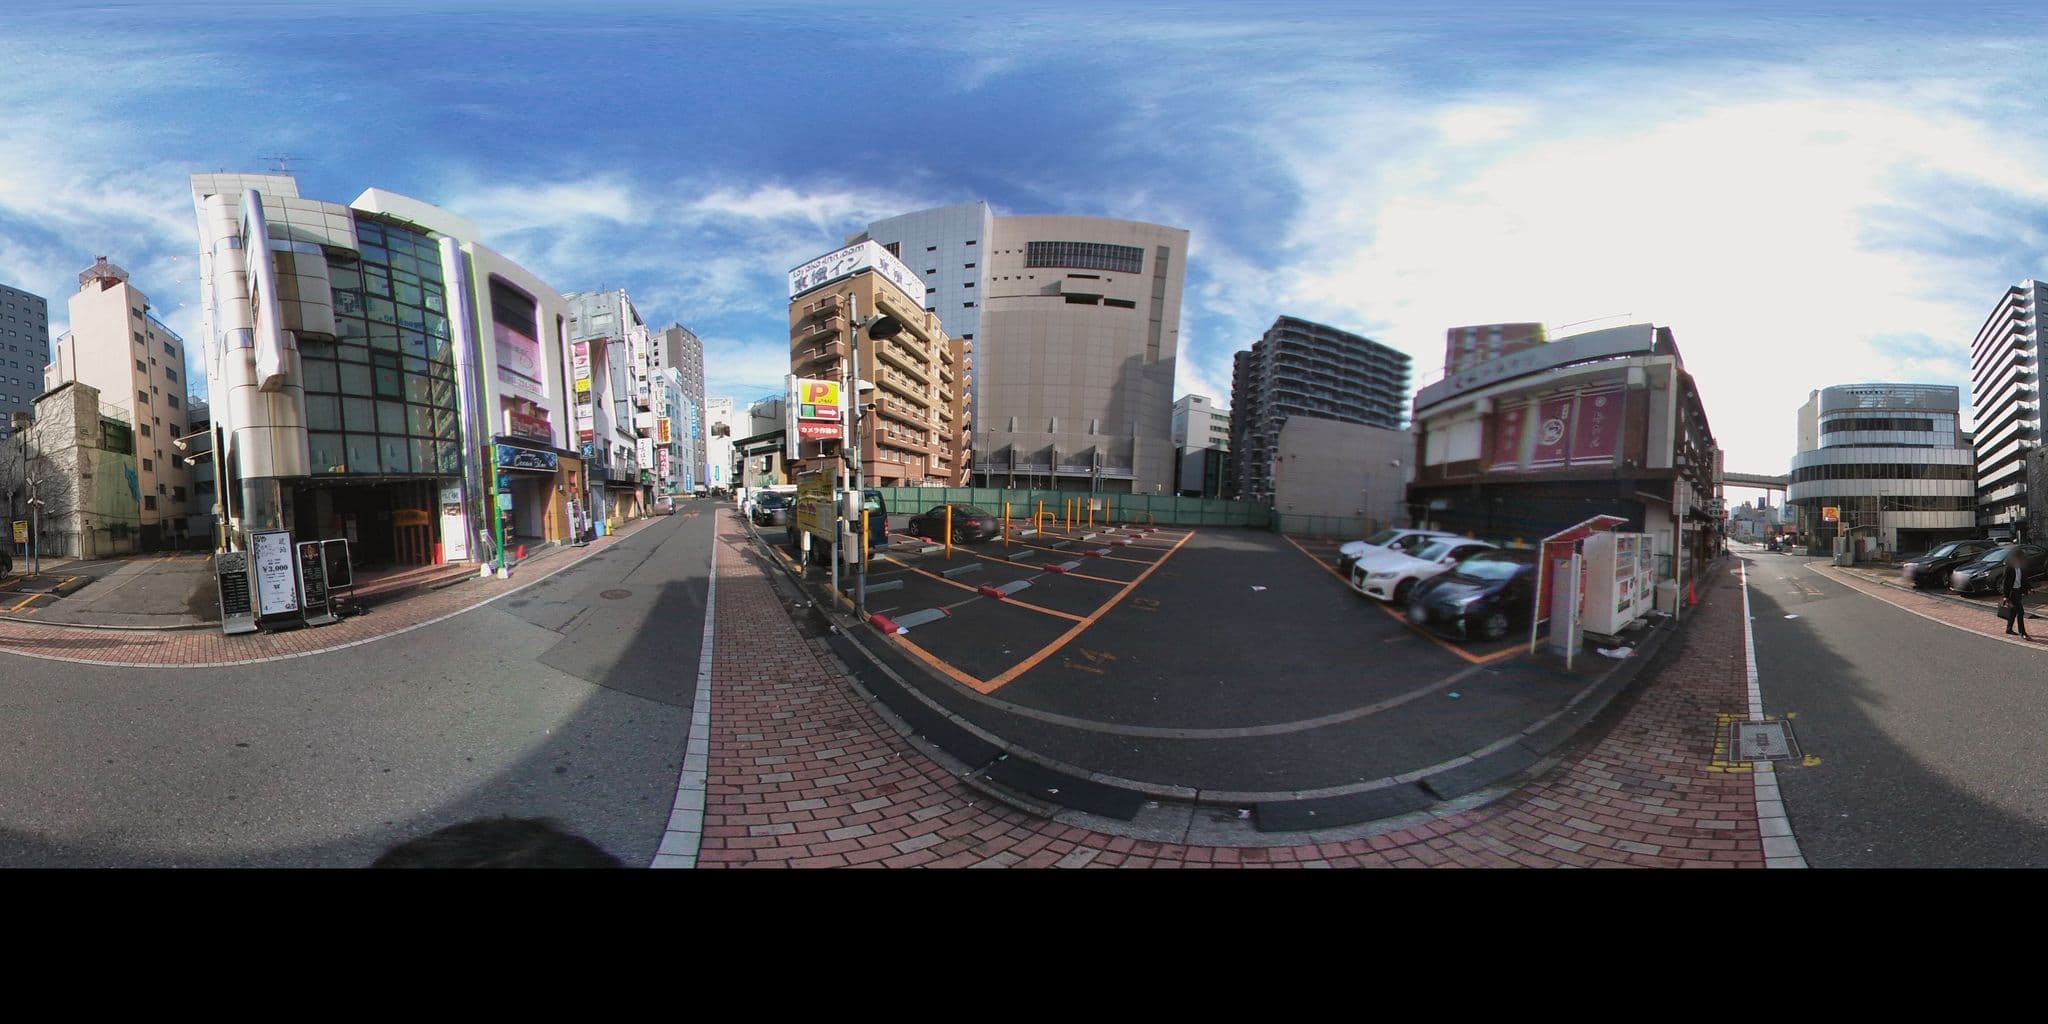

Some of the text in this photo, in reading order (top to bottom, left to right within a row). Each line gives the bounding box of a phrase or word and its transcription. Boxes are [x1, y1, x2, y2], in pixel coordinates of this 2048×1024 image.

[794, 256, 864, 293] 東横イン
[808, 383, 829, 403] P
